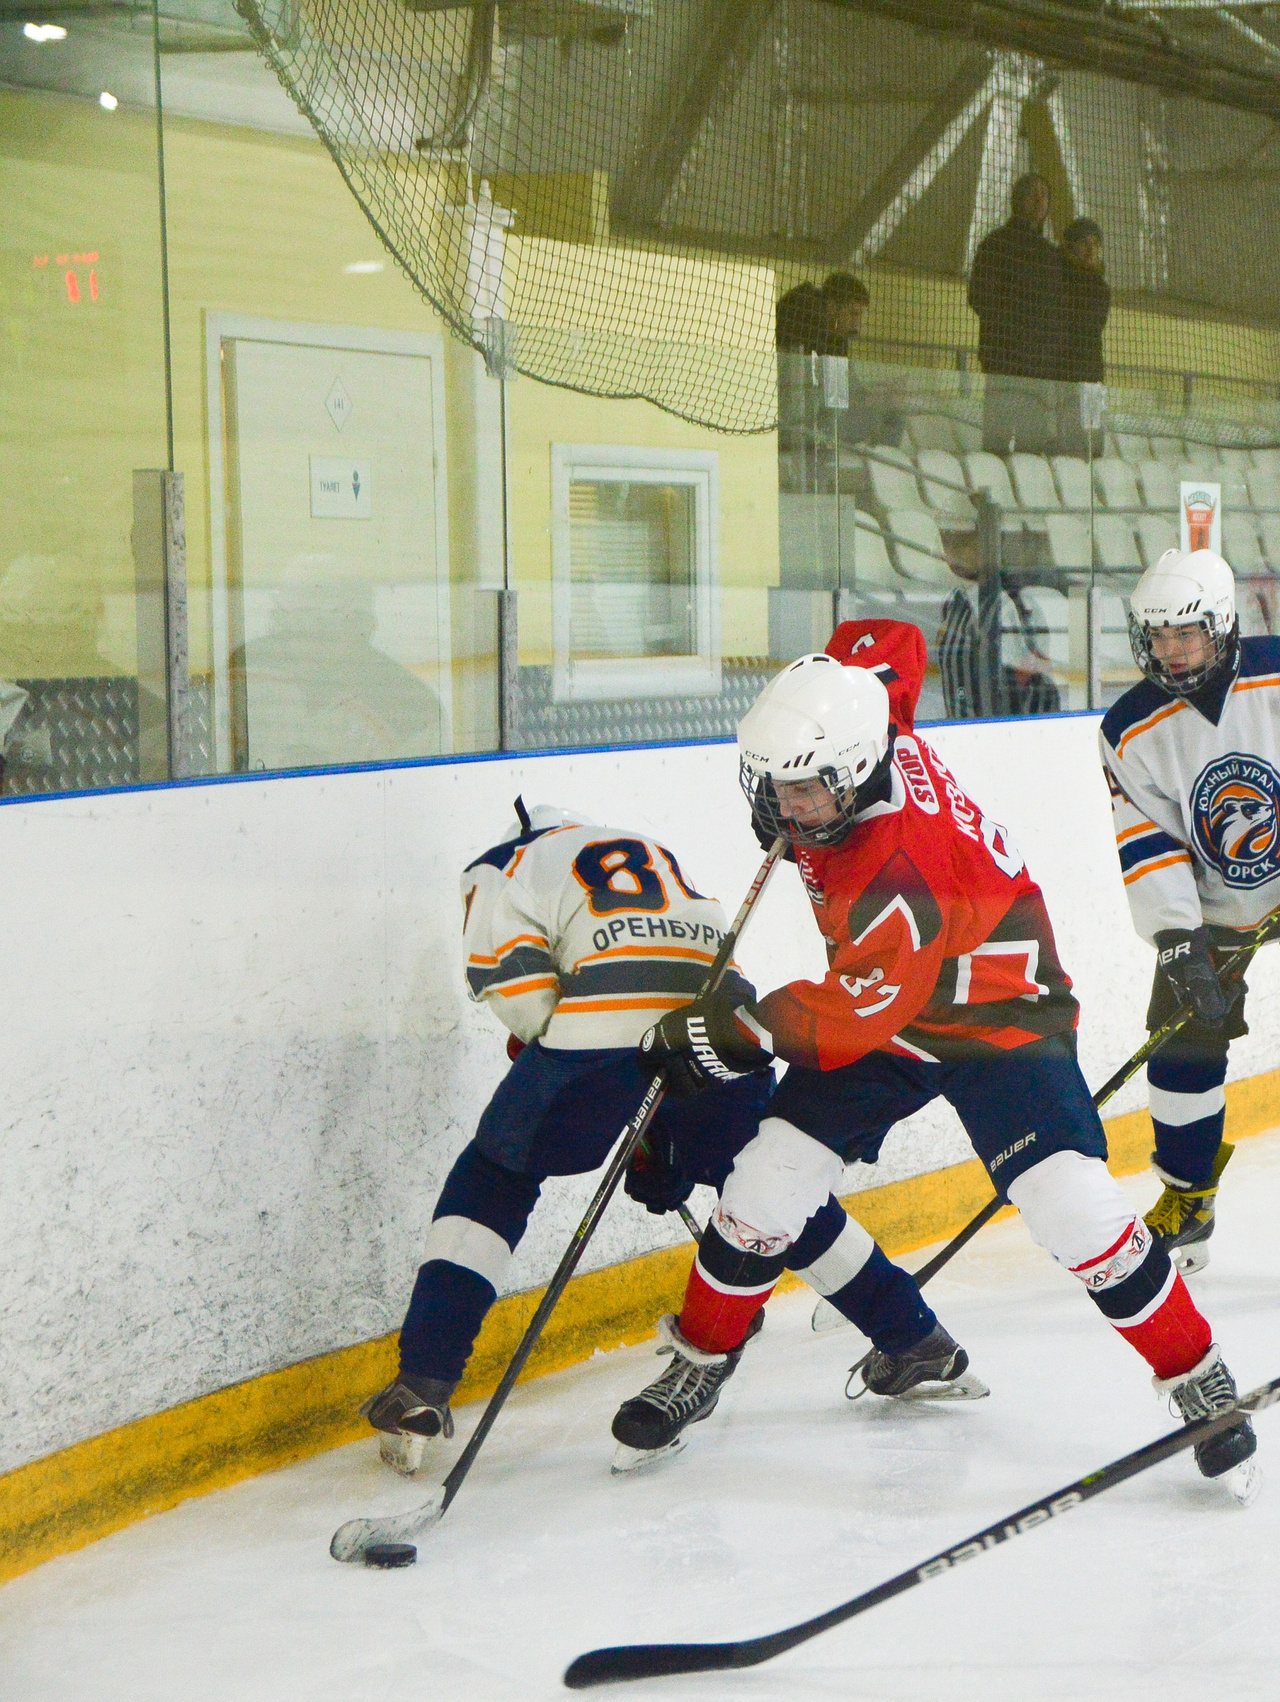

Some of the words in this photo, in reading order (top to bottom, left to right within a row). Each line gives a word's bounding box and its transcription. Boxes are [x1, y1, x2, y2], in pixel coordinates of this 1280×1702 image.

[744, 750, 770, 763] CCM
[838, 741, 860, 757] CCM
[896, 747, 936, 804] STOP
[1198, 760, 1240, 812] ЮЖНЫЙ
[1242, 765, 1274, 793] УРАЛ
[1227, 858, 1276, 879] ОРСК
[632, 1076, 662, 1131] BAUER
[990, 1131, 1037, 1173] BAUER
